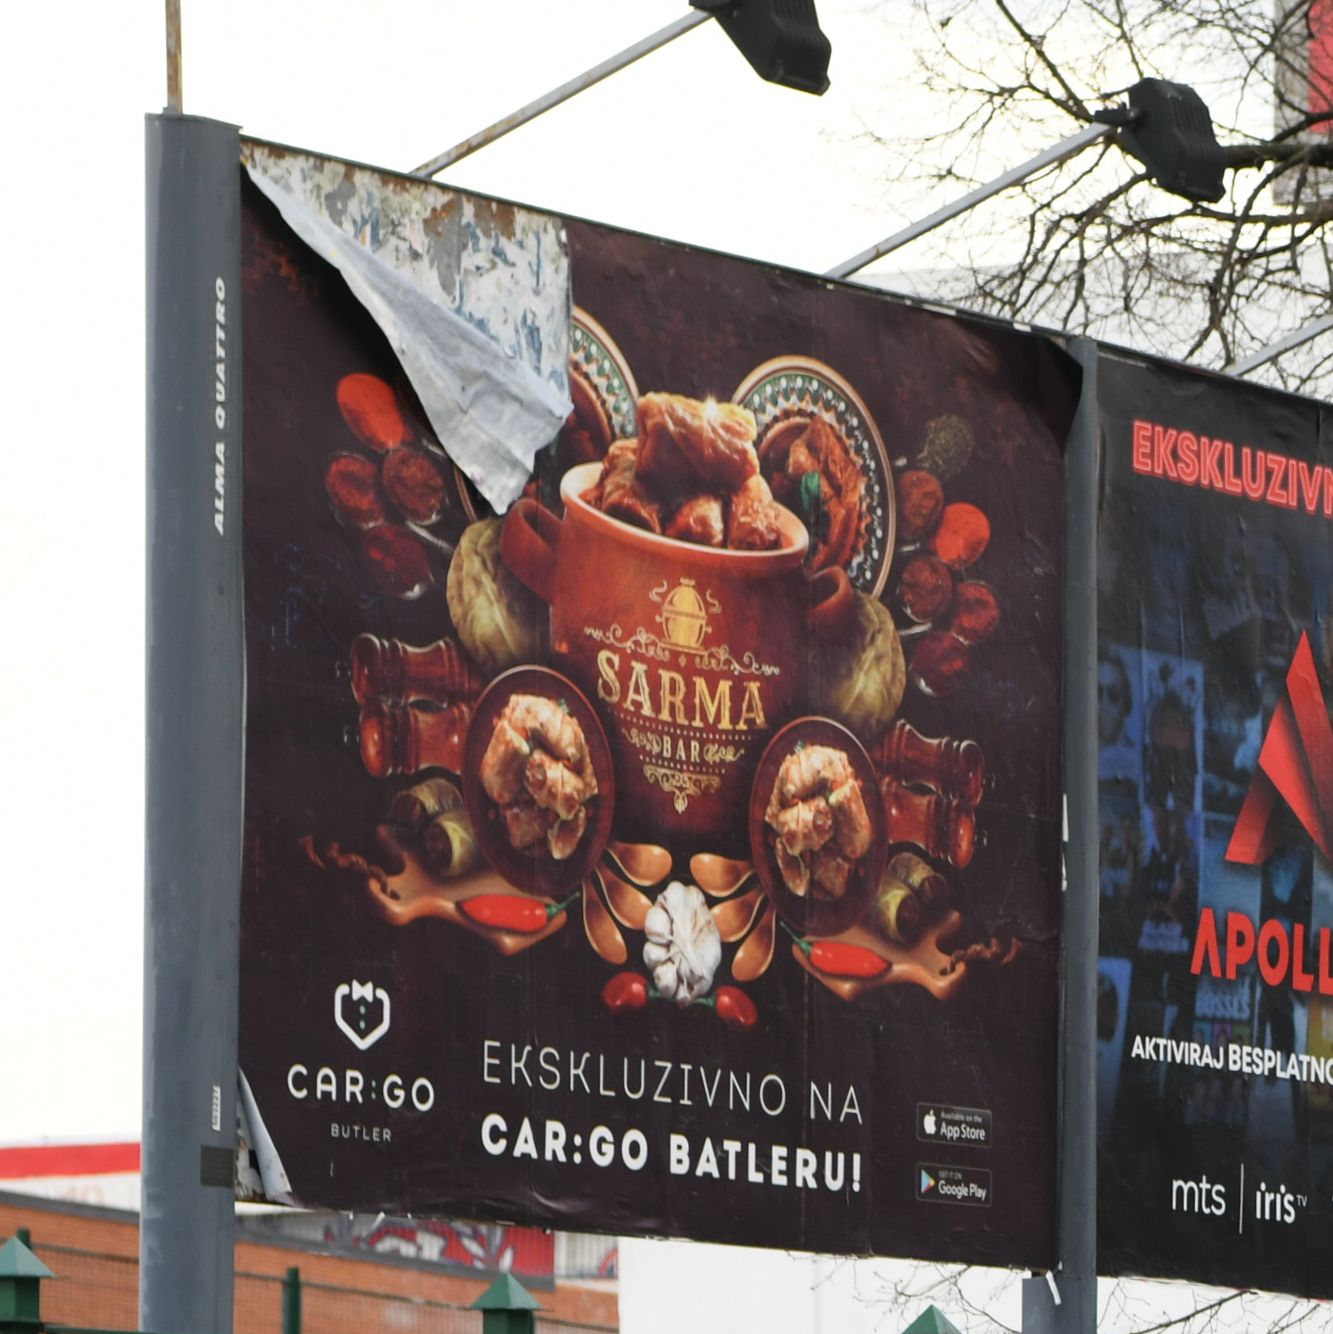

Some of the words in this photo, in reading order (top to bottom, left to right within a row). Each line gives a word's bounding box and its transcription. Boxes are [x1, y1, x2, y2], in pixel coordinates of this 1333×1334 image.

[215, 276, 228, 430] QUATTRO
[214, 442, 226, 536] ALMA
[596, 649, 768, 731] SARMA
[662, 737, 701, 764] BAR
[1131, 1035, 1224, 1070] AKTIVIRAJ
[288, 1063, 435, 1112] CAR:GO
[483, 1040, 786, 1117] EKSKLUZIVNO
[810, 1081, 863, 1124] NA
[330, 1122, 392, 1142] BUTLER
[940, 1121, 960, 1141] App
[961, 1123, 986, 1141] Store
[481, 1113, 648, 1170] CAR:GO
[669, 1133, 861, 1193] BATLERU!
[938, 1180, 968, 1199] Google
[969, 1183, 987, 1201] Play
[1172, 1175, 1226, 1216] mts
[1256, 1182, 1296, 1224] iris
